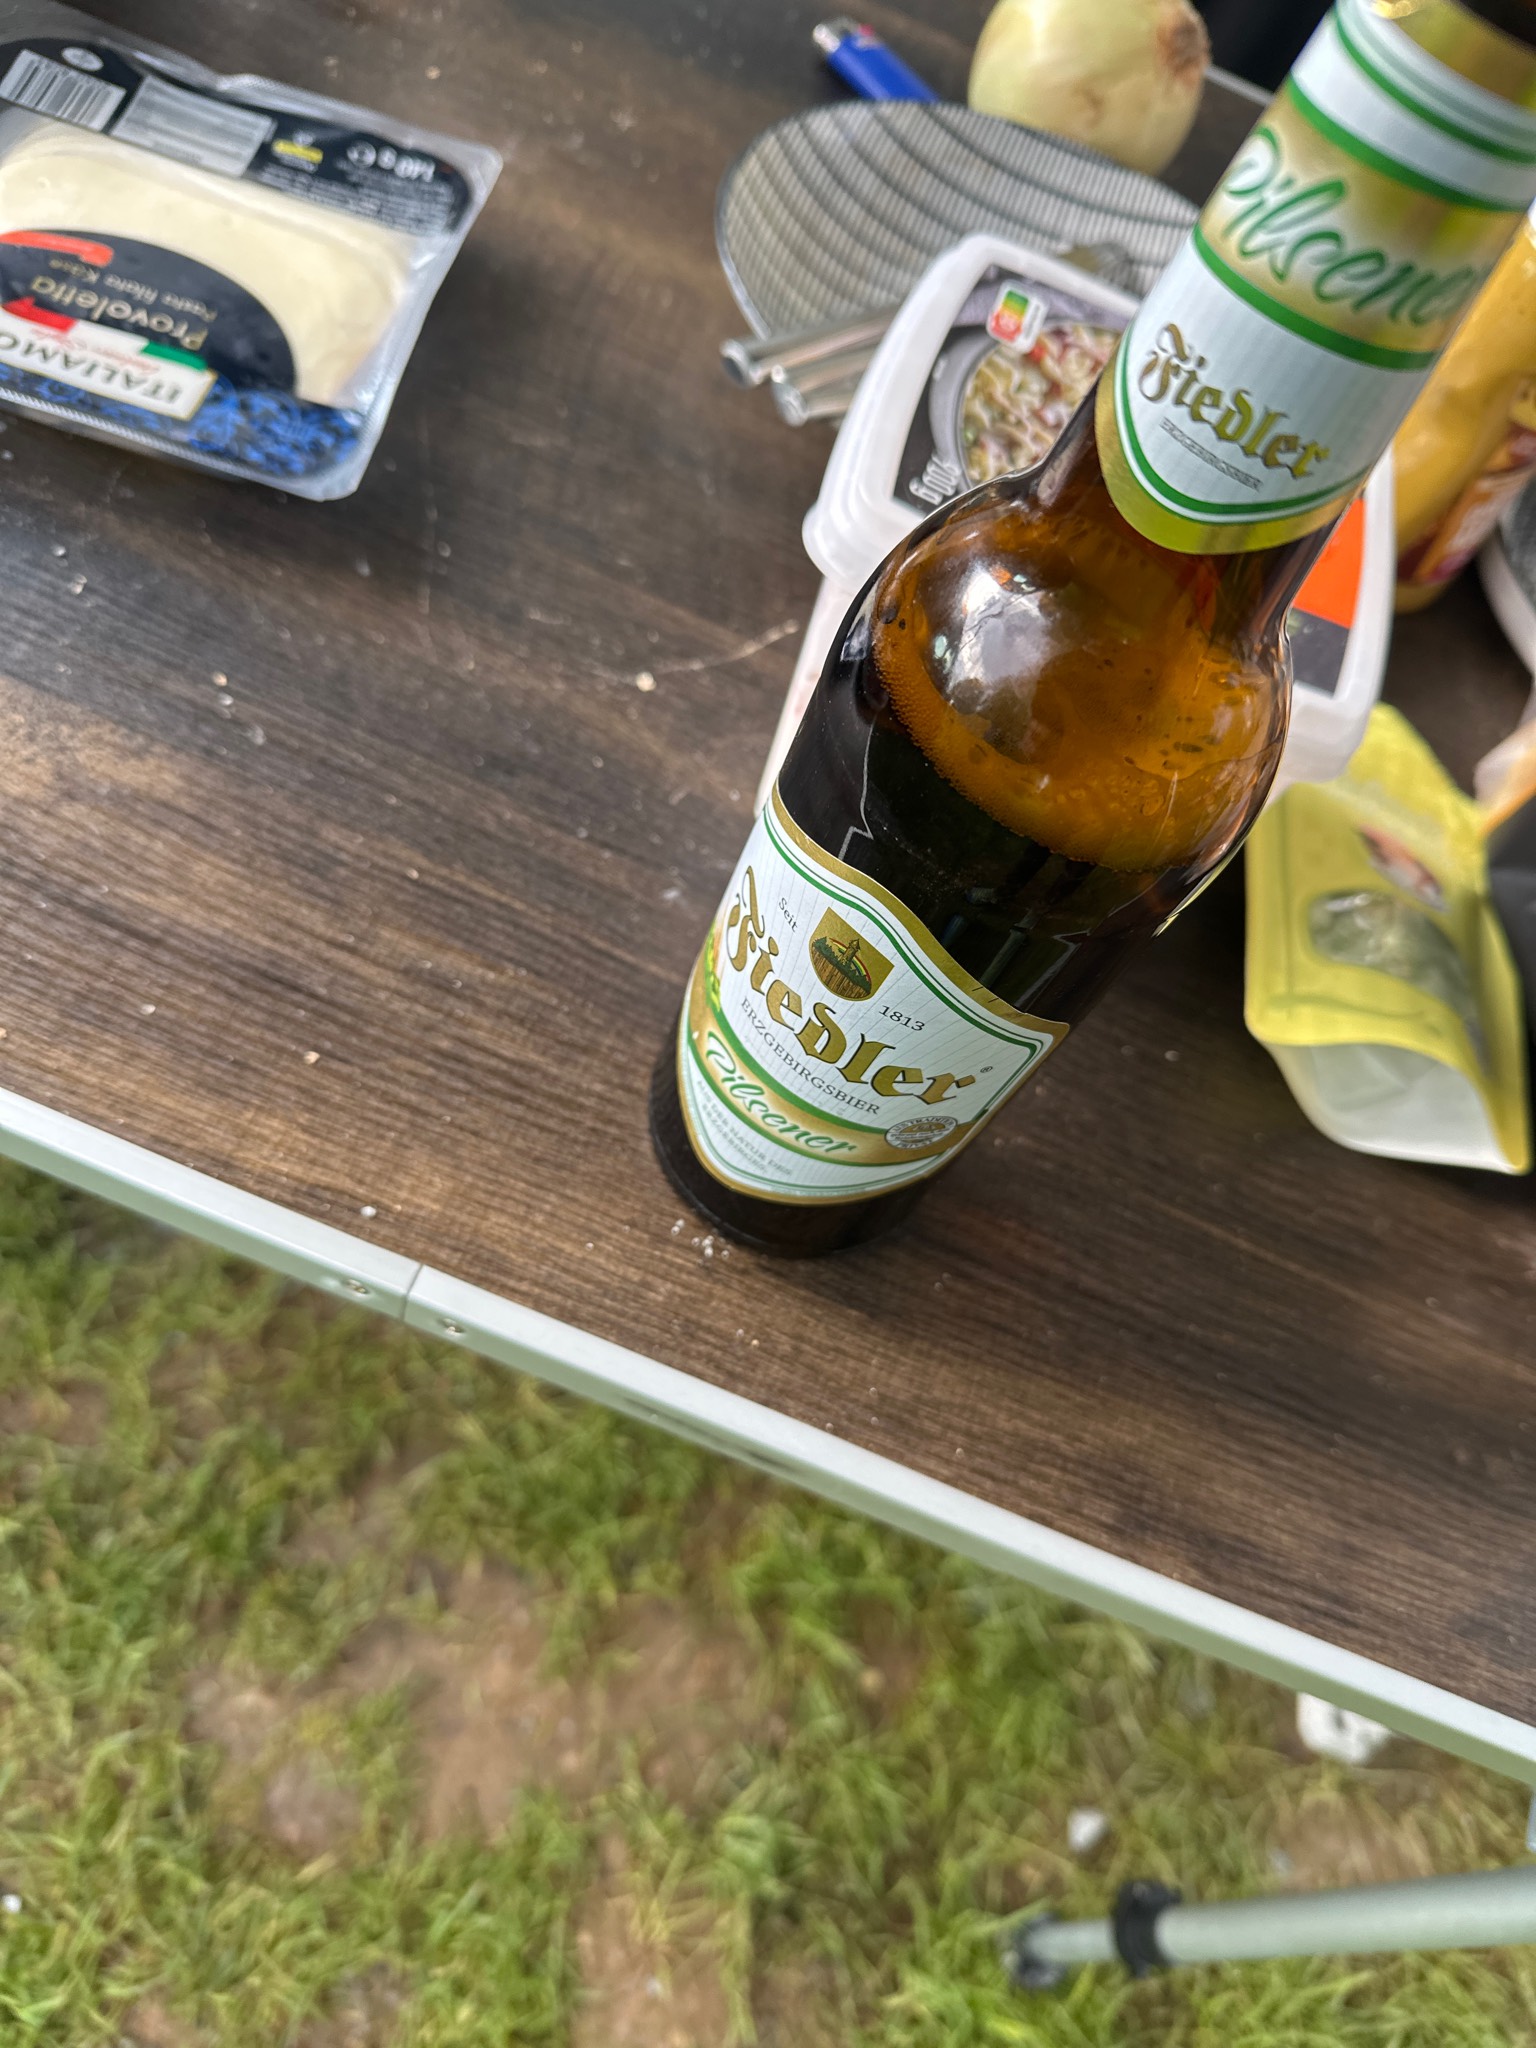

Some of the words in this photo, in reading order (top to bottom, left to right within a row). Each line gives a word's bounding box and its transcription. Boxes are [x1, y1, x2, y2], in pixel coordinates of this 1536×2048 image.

[31, 275, 209, 350] Provoletta
[1138, 323, 1331, 480] Fiedler
[726, 866, 976, 1105] Fiedler
[778, 897, 798, 934] Seit
[879, 1005, 926, 1032] 1813
[706, 1031, 858, 1153] Pilsener
[741, 996, 881, 1115] ERZGEBIRGSBIER
[711, 1101, 730, 1126] DER
[729, 1122, 770, 1161] NATUR
